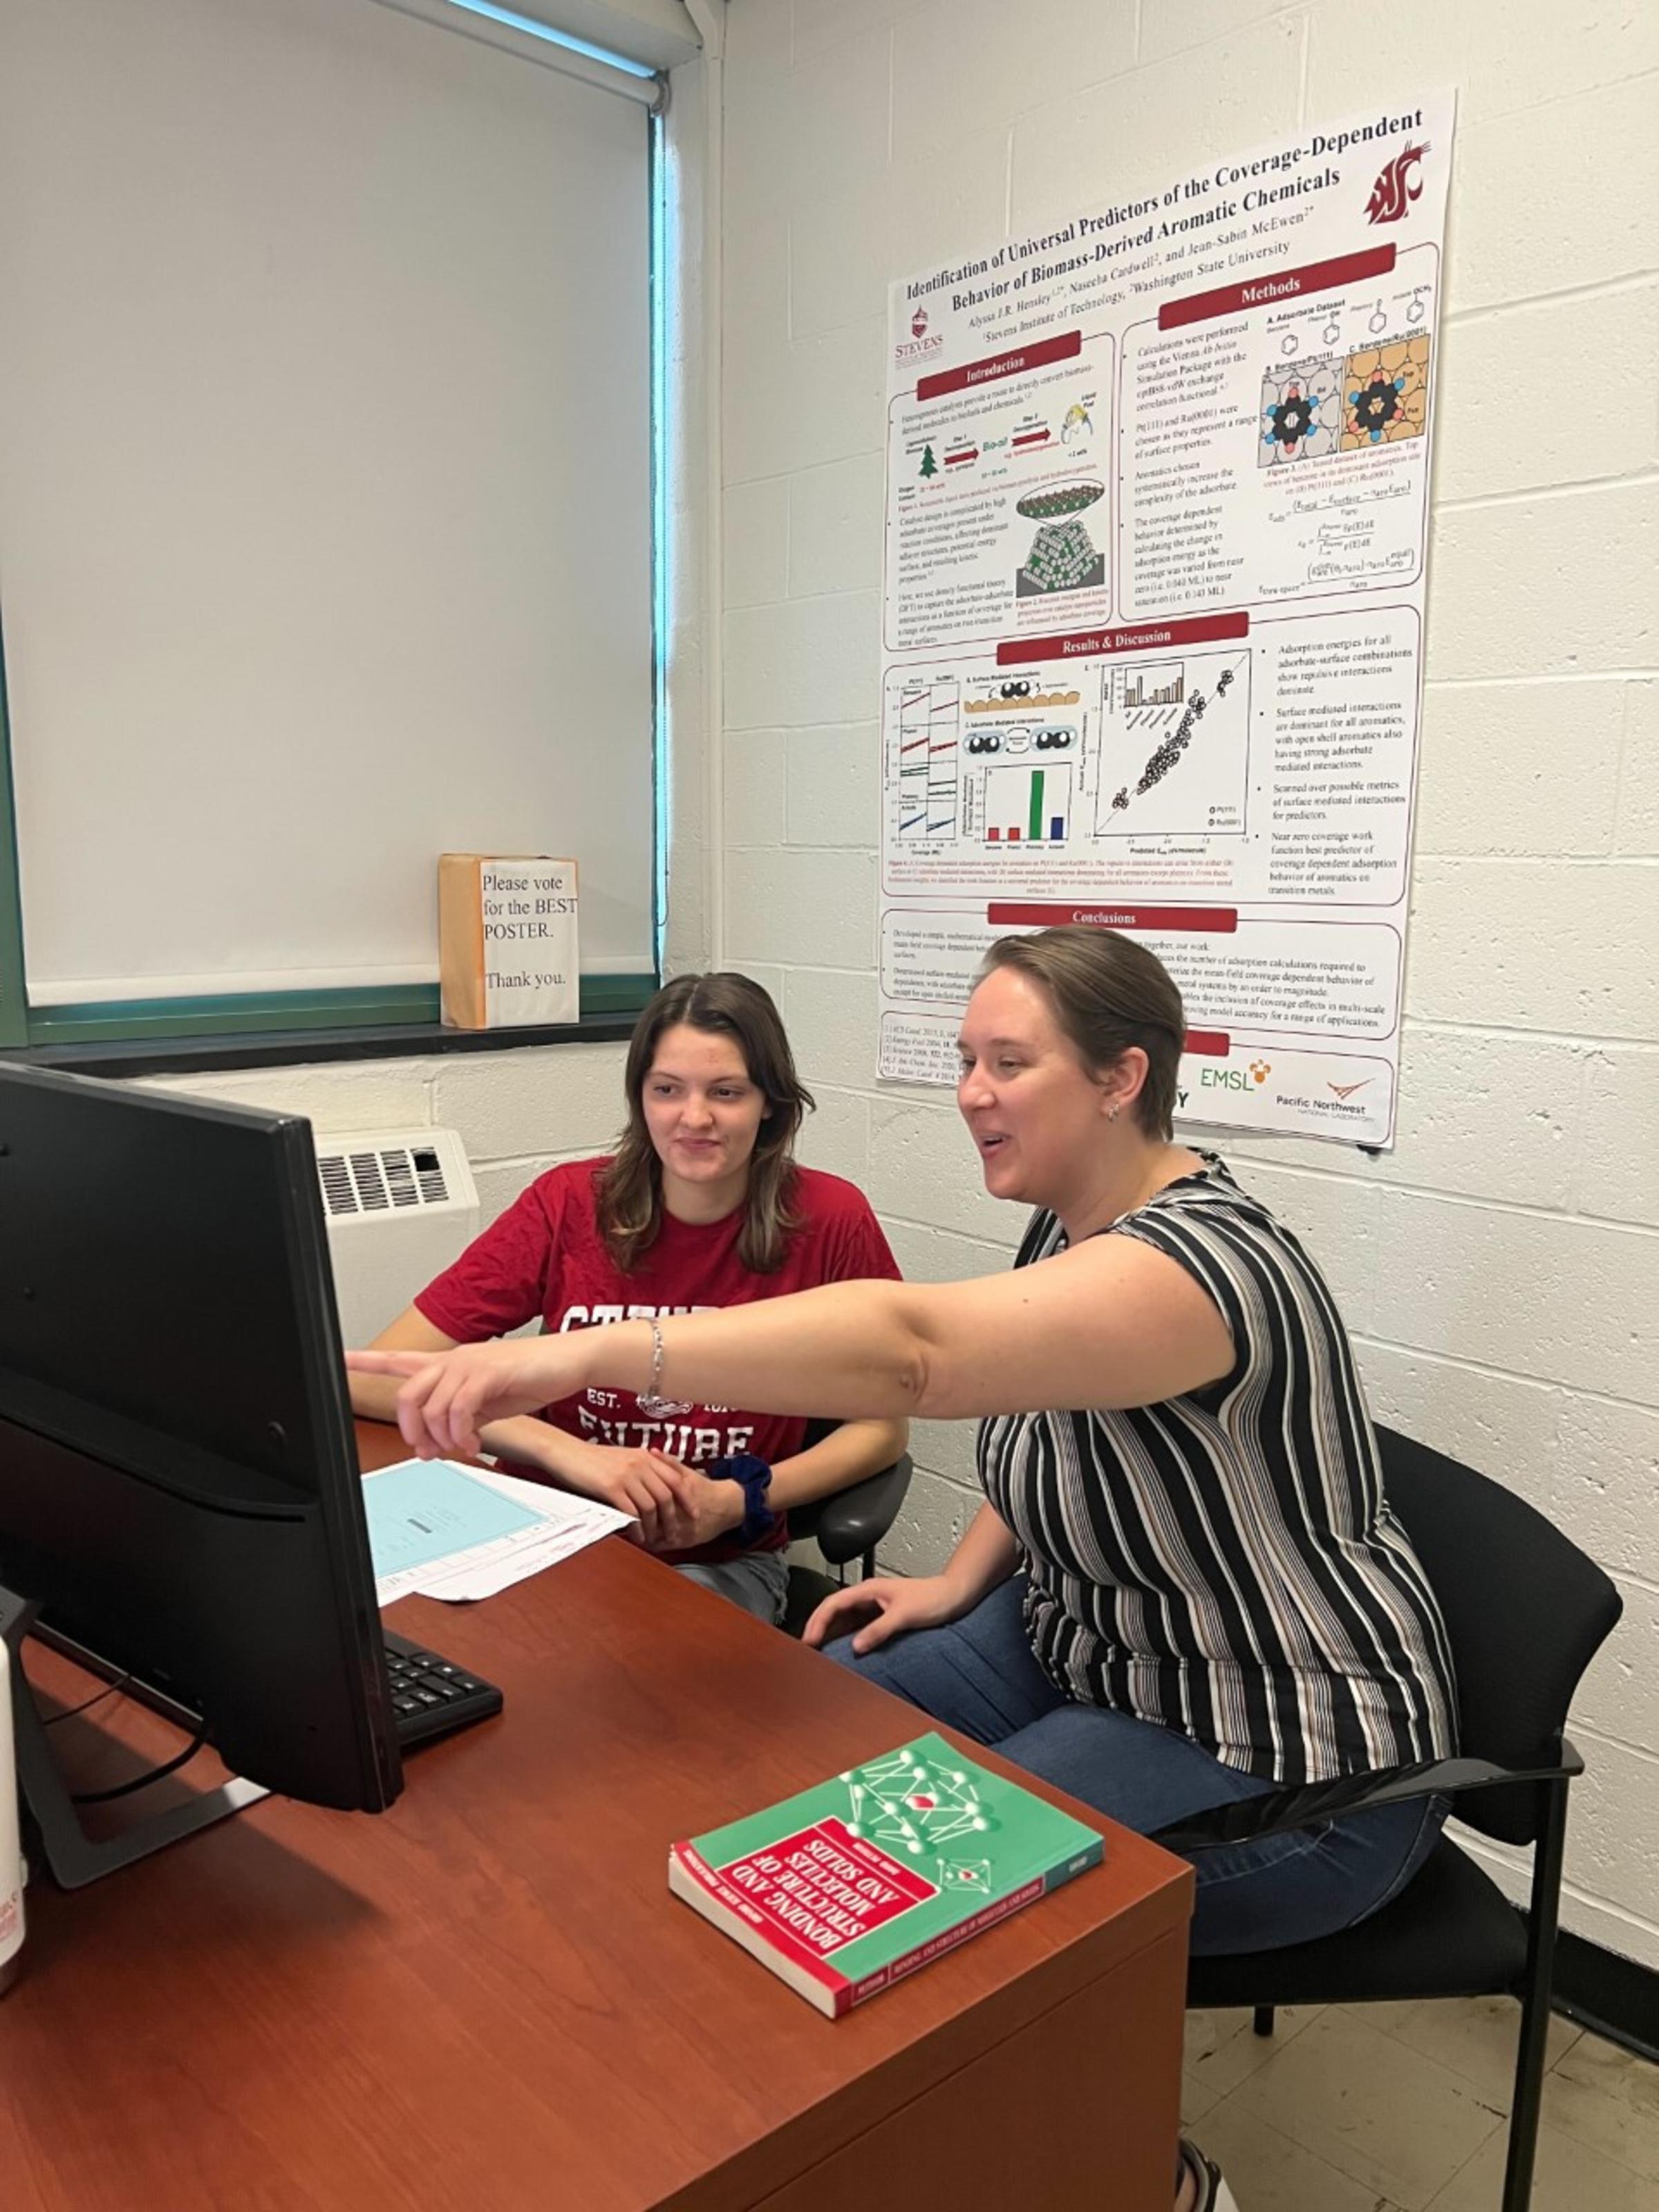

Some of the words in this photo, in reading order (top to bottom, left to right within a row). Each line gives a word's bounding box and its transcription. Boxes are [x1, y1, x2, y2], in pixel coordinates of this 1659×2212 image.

[907, 260, 988, 299] Identification
[992, 249, 1004, 268] of
[1008, 223, 1076, 261] Universal
[1079, 197, 1159, 236] Predictors
[1164, 184, 1180, 206] of
[1184, 178, 1210, 198] the
[1215, 109, 1423, 187] Coverage-Dependent
[952, 281, 1010, 311] Behavior
[1013, 271, 1028, 290] of
[1031, 226, 1153, 283] Biomass-Derived
[1157, 200, 1237, 239] Aromatic
[1243, 167, 1340, 212] Chemicals
[968, 312, 995, 328] Alyssa
[1165, 246, 1185, 262] and
[1187, 228, 1247, 256] Jean-Sabin
[1020, 312, 1055, 332] Institute
[1057, 305, 1068, 319] of
[1197, 260, 1224, 276] State
[1228, 241, 1290, 267] University
[1241, 277, 1300, 304] Methods
[1206, 321, 1248, 341] performed
[895, 335, 943, 358] STEVENS
[1234, 353, 1247, 362] the
[967, 357, 1025, 382] Introduction
[1062, 639, 1099, 653] Results
[1116, 630, 1171, 647] Discussion
[1365, 637, 1378, 646] for
[1380, 635, 1391, 645] all
[1331, 719, 1343, 728] for
[1346, 718, 1357, 727] all
[1384, 729, 1403, 739] also
[483, 875, 528, 891] Please
[534, 878, 563, 890] vote
[485, 900, 505, 915] for
[509, 901, 530, 915] the
[535, 899, 578, 914] BEST
[1073, 910, 1136, 924] Conclusions
[485, 923, 554, 940] POSTER.
[485, 971, 531, 988] Thank
[536, 973, 566, 989] you.
[1201, 1068, 1255, 1091] EMSL
[1277, 1095, 1309, 1108] Pacific
[1313, 1100, 1366, 1114] Northwest
[587, 1387, 621, 1409] EST.
[752, 1855, 782, 1873] OF
[803, 1839, 864, 1881] SOLIDS
[732, 1865, 775, 1893] AND
[784, 1851, 876, 1917] MOLECULES
[856, 1877, 900, 1904] AND
[773, 1870, 866, 1937] STRUCTURE
[764, 1891, 842, 1949] BONDING
